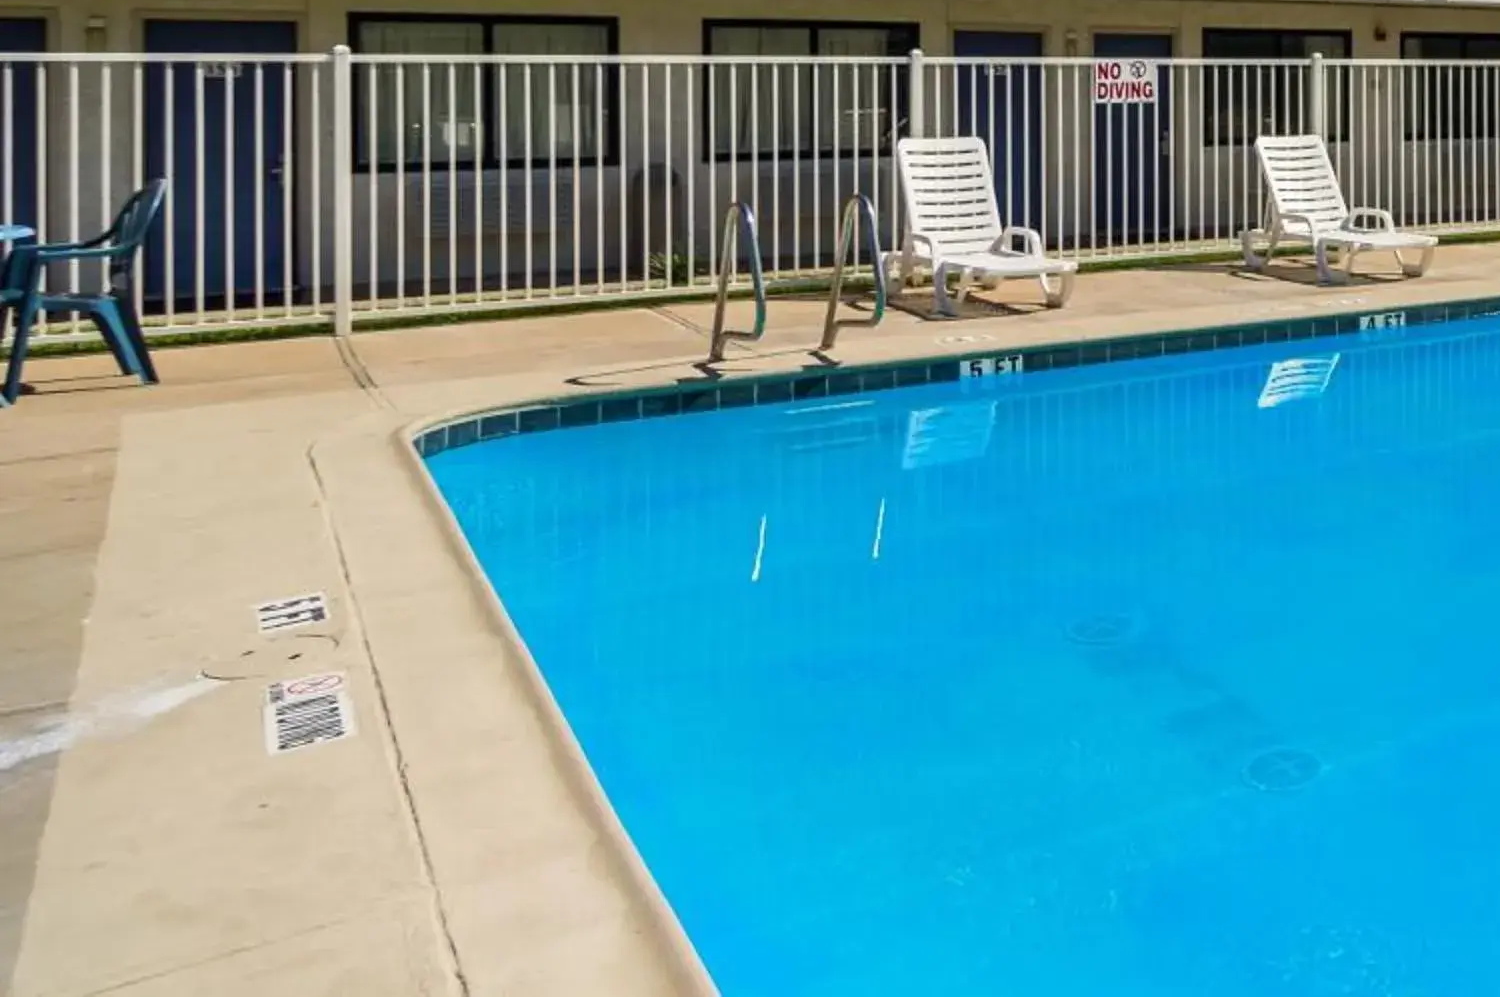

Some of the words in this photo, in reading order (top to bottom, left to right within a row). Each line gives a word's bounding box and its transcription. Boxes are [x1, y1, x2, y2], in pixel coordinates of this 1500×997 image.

[1098, 63, 1121, 80] NO
[1098, 82, 1153, 99] DIVING
[969, 360, 983, 378] 5
[995, 356, 1019, 376] FT
[260, 606, 326, 631] FT
